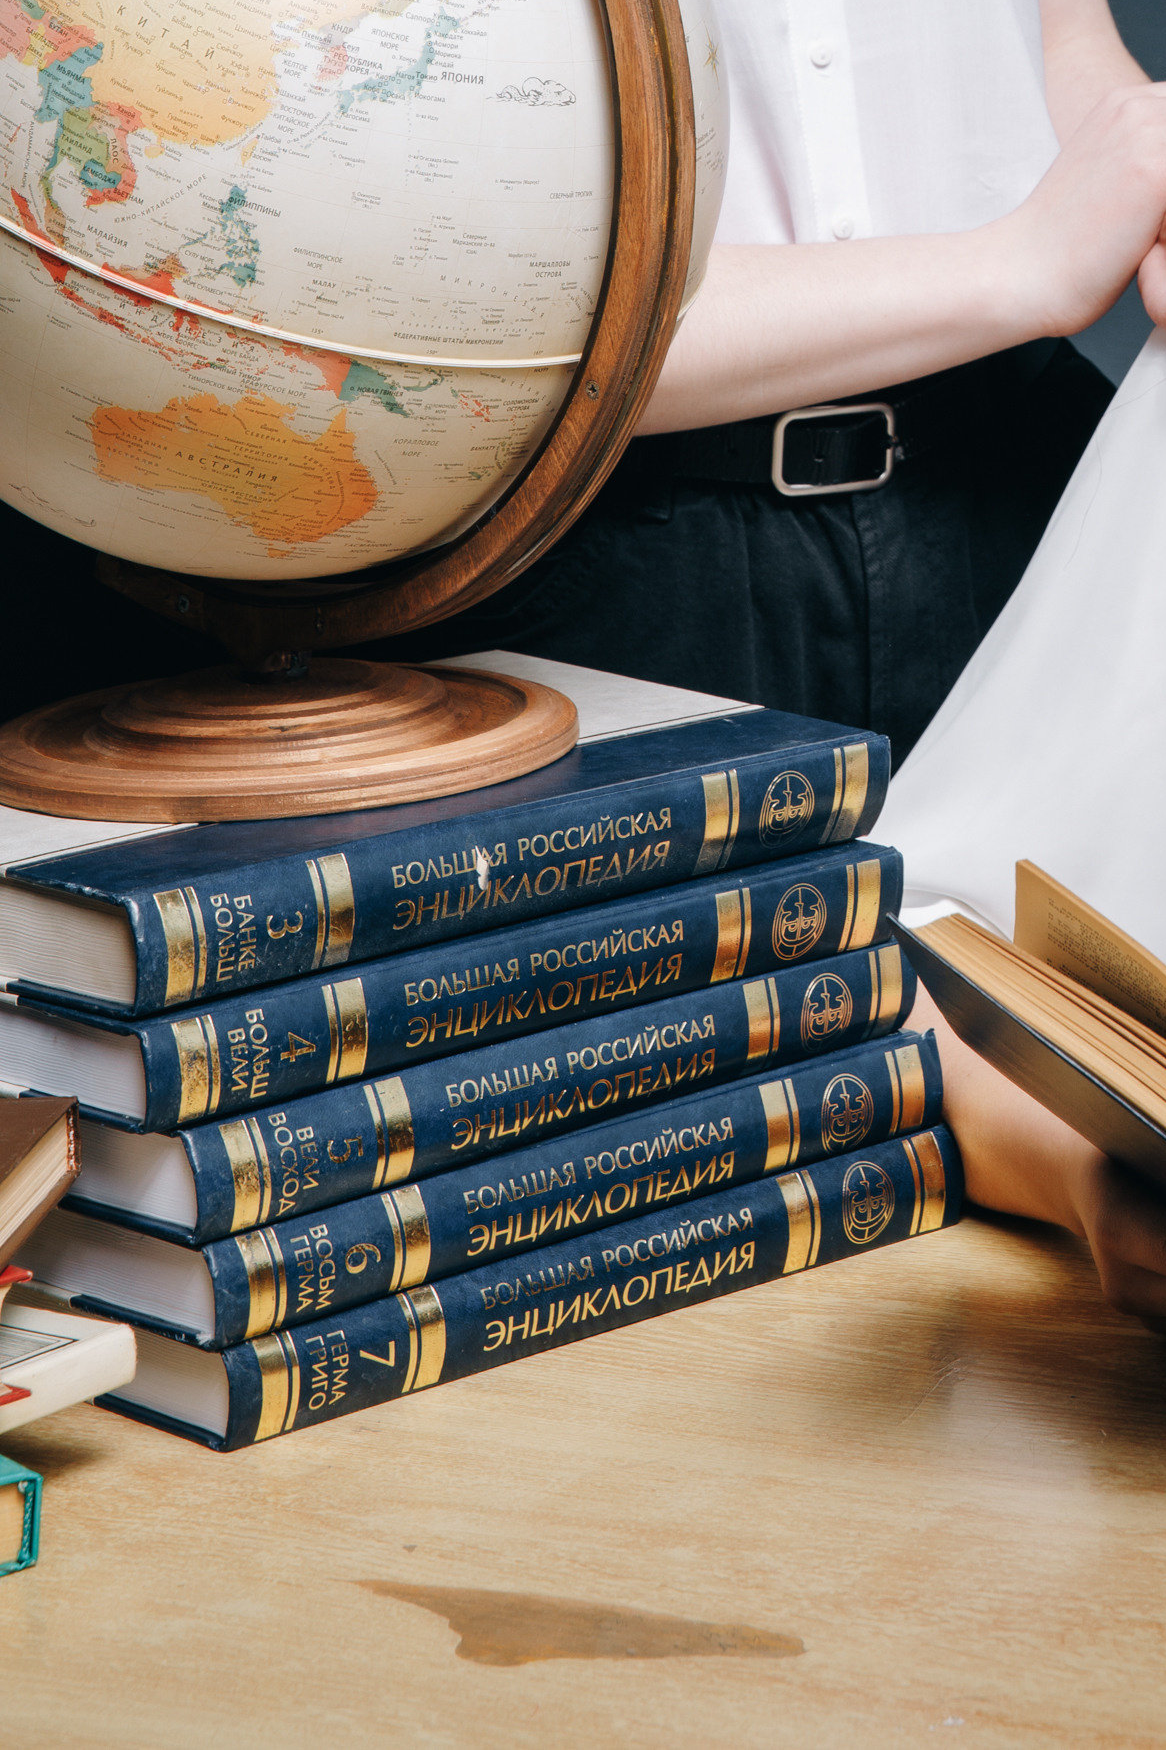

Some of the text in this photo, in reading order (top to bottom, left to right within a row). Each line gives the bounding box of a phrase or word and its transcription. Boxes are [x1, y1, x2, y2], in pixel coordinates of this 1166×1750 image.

[331, 22, 354, 35] КНДР
[371, 28, 410, 43] ЯПОНСКОЕ
[333, 52, 383, 71] РЕСПУБЛИКА
[342, 41, 360, 53] Сеул
[380, 42, 400, 52] МОРЕ
[57, 63, 86, 85] МЬЯНМА
[281, 58, 309, 73] ЖЕЛТОЕ
[283, 67, 302, 79] МОРЕ
[345, 63, 370, 76] КОРЕЯ
[415, 71, 439, 83] Токио
[441, 71, 485, 86] ЯПОНИЯ
[277, 124, 295, 135] МОРЕ
[110, 137, 120, 164] ЛАОС
[114, 173, 208, 224] ЮЖНО-КИТАЙСКОЕ МОРЕ
[87, 224, 129, 249] МАЛАЙЗИЯ
[293, 246, 344, 264] ФИЛИППИНСКОЕ
[306, 260, 323, 271] МОРЕ
[529, 260, 571, 268] МАРШАЛЛОВЫ
[535, 271, 562, 279] ОСТРОВА
[393, 331, 442, 344] ФЕДЕРАТИВНЫЕ
[442, 336, 465, 345] ШТАТЫ
[187, 373, 245, 395] ТИМОРСКОЕ МОРЕ
[239, 371, 262, 382] ТИМОР
[240, 378, 307, 399] АРАФУРСКОЕ МОРЕ
[393, 438, 441, 447] КОРАЛЛОВОЕ
[175, 450, 279, 483] АВСТРАЛИЯ
[391, 807, 672, 889] БОЛЬШАЯ РОССИЙСКАЯ
[392, 840, 671, 931] ЭНЦИКЛОПЕДИЯ
[209, 893, 235, 983] БОЛЬШ
[233, 894, 259, 972] БАНКЕ
[266, 911, 304, 940] 3
[403, 919, 684, 1006] БОЛЬШАЯ РОССИЙСКАЯ
[406, 953, 683, 1048] ЭНЦИКЛОПЕДИЯ
[227, 1027, 249, 1092] ВЕЛИ
[244, 1008, 270, 1099] БОЛЬШ
[280, 1031, 317, 1063] 4
[445, 1014, 717, 1109] БОЛЬШАЯ РОССИЙСКАЯ
[451, 1048, 717, 1151] ЭНЦИКЛОПЕДИЯ
[267, 1111, 300, 1217] ВОСХОД
[296, 1125, 319, 1190] ВЕЛИ
[327, 1135, 364, 1164] 5
[463, 1117, 735, 1215] БОЛЬШАЯ РОССИЙСКАЯ
[466, 1151, 736, 1257] ЭНЦИКЛОПЕДИЯ
[309, 1223, 337, 1311] ВОСЬМ
[344, 1242, 381, 1274] 6
[480, 1207, 754, 1311] БОЛЬШАЯ РОССИЙСКАЯ
[290, 1234, 314, 1314] ГЕРМА
[483, 1241, 757, 1352] ЭНЦИКЛОПЕДИЯ
[326, 1329, 349, 1405] ГЕРМА
[359, 1340, 396, 1368] 7
[305, 1335, 327, 1411] ГРИГО
